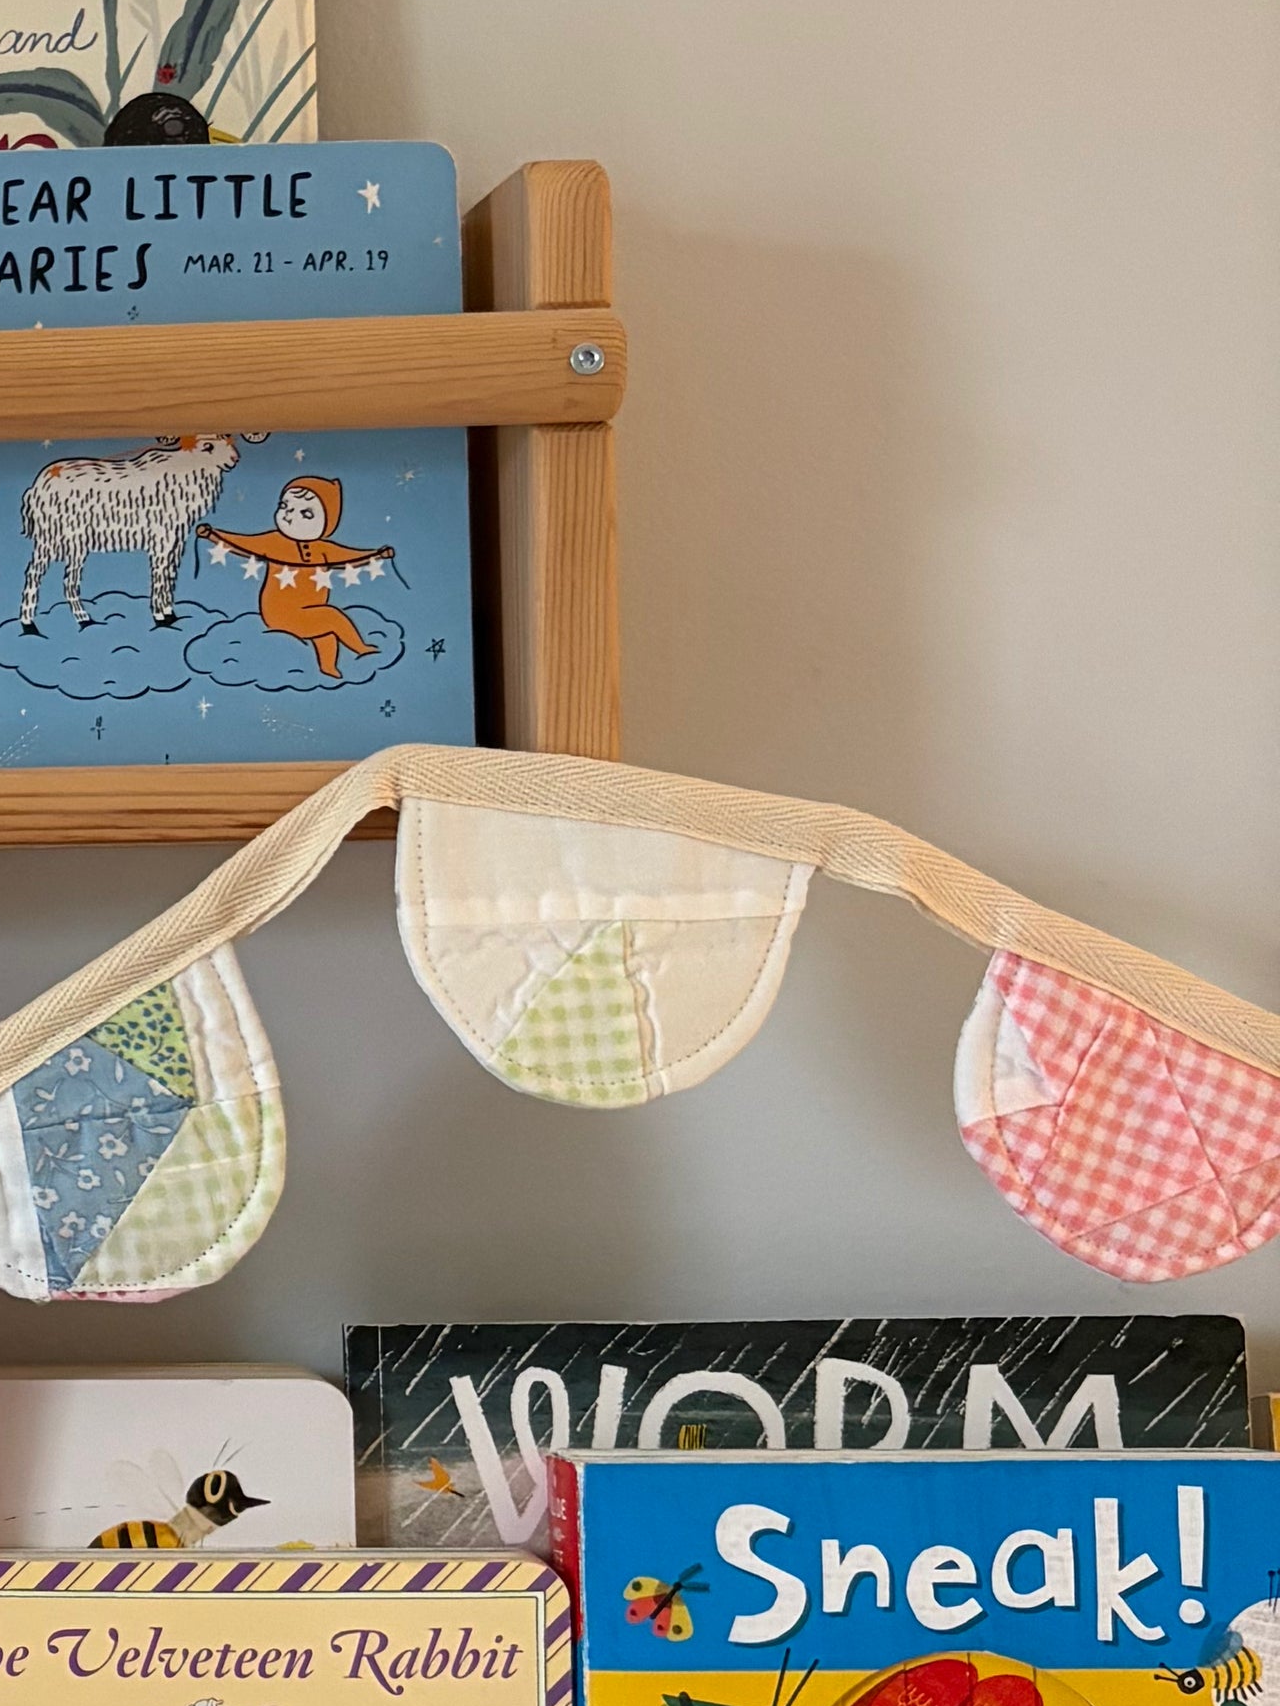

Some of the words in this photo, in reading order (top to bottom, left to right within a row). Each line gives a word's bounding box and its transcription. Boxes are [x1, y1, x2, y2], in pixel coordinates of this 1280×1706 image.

[125, 171, 312, 221] LITTLE
[184, 254, 242, 274] MAR.
[253, 251, 274, 274] 21
[302, 250, 355, 272] APR.
[365, 249, 390, 271] 19
[715, 1484, 1208, 1644] Sneak!
[47, 1626, 315, 1680] Velveteen
[330, 1626, 524, 1696] Rabbit
